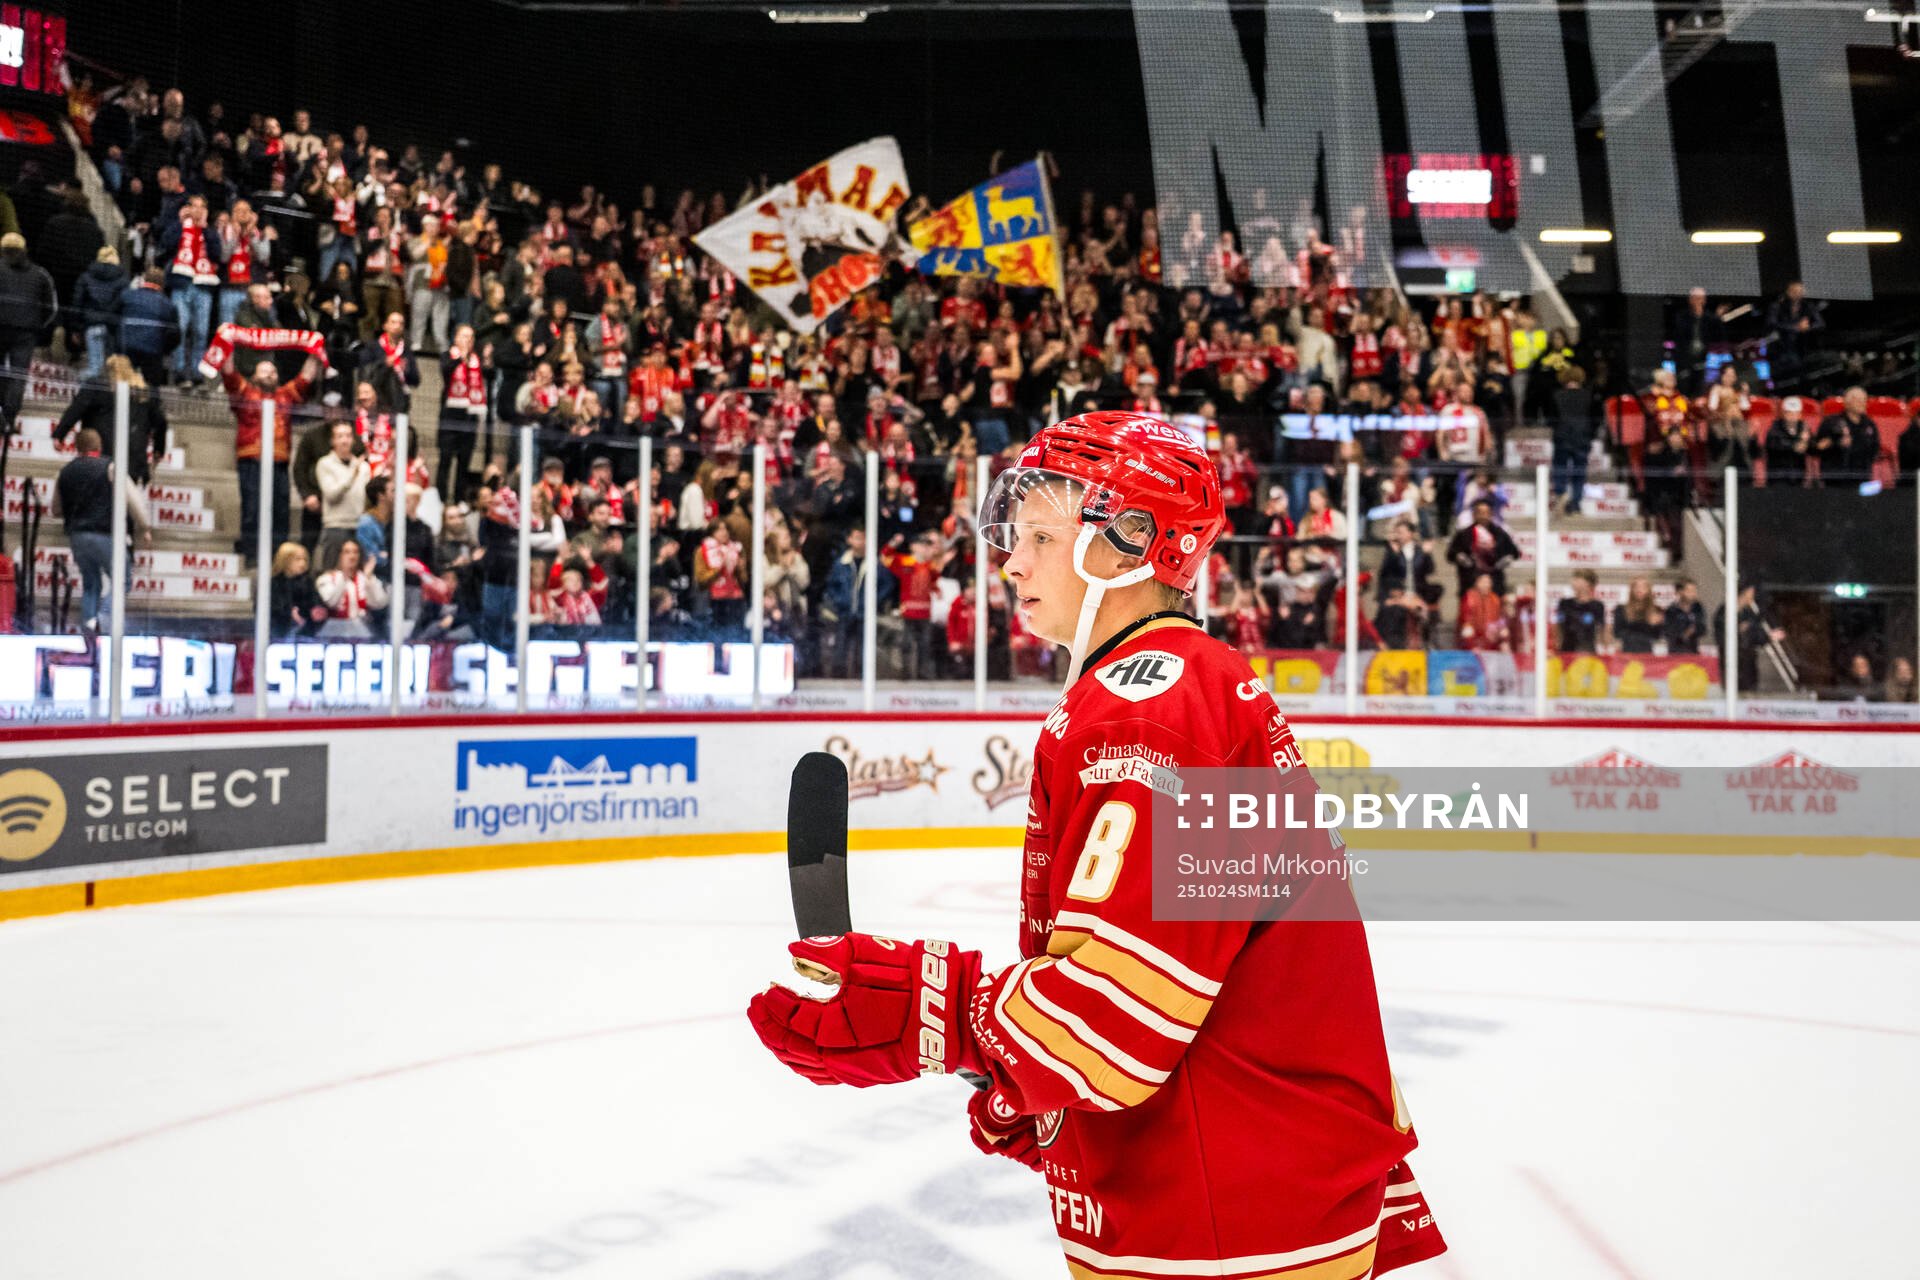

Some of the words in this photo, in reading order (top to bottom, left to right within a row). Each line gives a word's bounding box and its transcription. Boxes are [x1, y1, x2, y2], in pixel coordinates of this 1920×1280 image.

[149, 486, 191, 500] MAXI
[158, 507, 203, 523] MAXI
[181, 553, 226, 569] MAXI
[193, 576, 238, 593] MAXI
[1106, 658, 1168, 686] HLL
[1089, 768, 1112, 780] ur
[1117, 761, 1129, 779] &
[1129, 760, 1176, 794] Fasad
[85, 767, 290, 819] SELECT
[1572, 791, 1617, 810] TAK
[1627, 791, 1660, 810] AB
[1748, 793, 1794, 814] TAK
[1804, 794, 1837, 814] AB
[454, 792, 698, 837] ingenjörsfirman
[85, 818, 188, 843] TELECOM
[1067, 800, 1136, 903] 8
[978, 991, 1018, 1066] KALMAR
